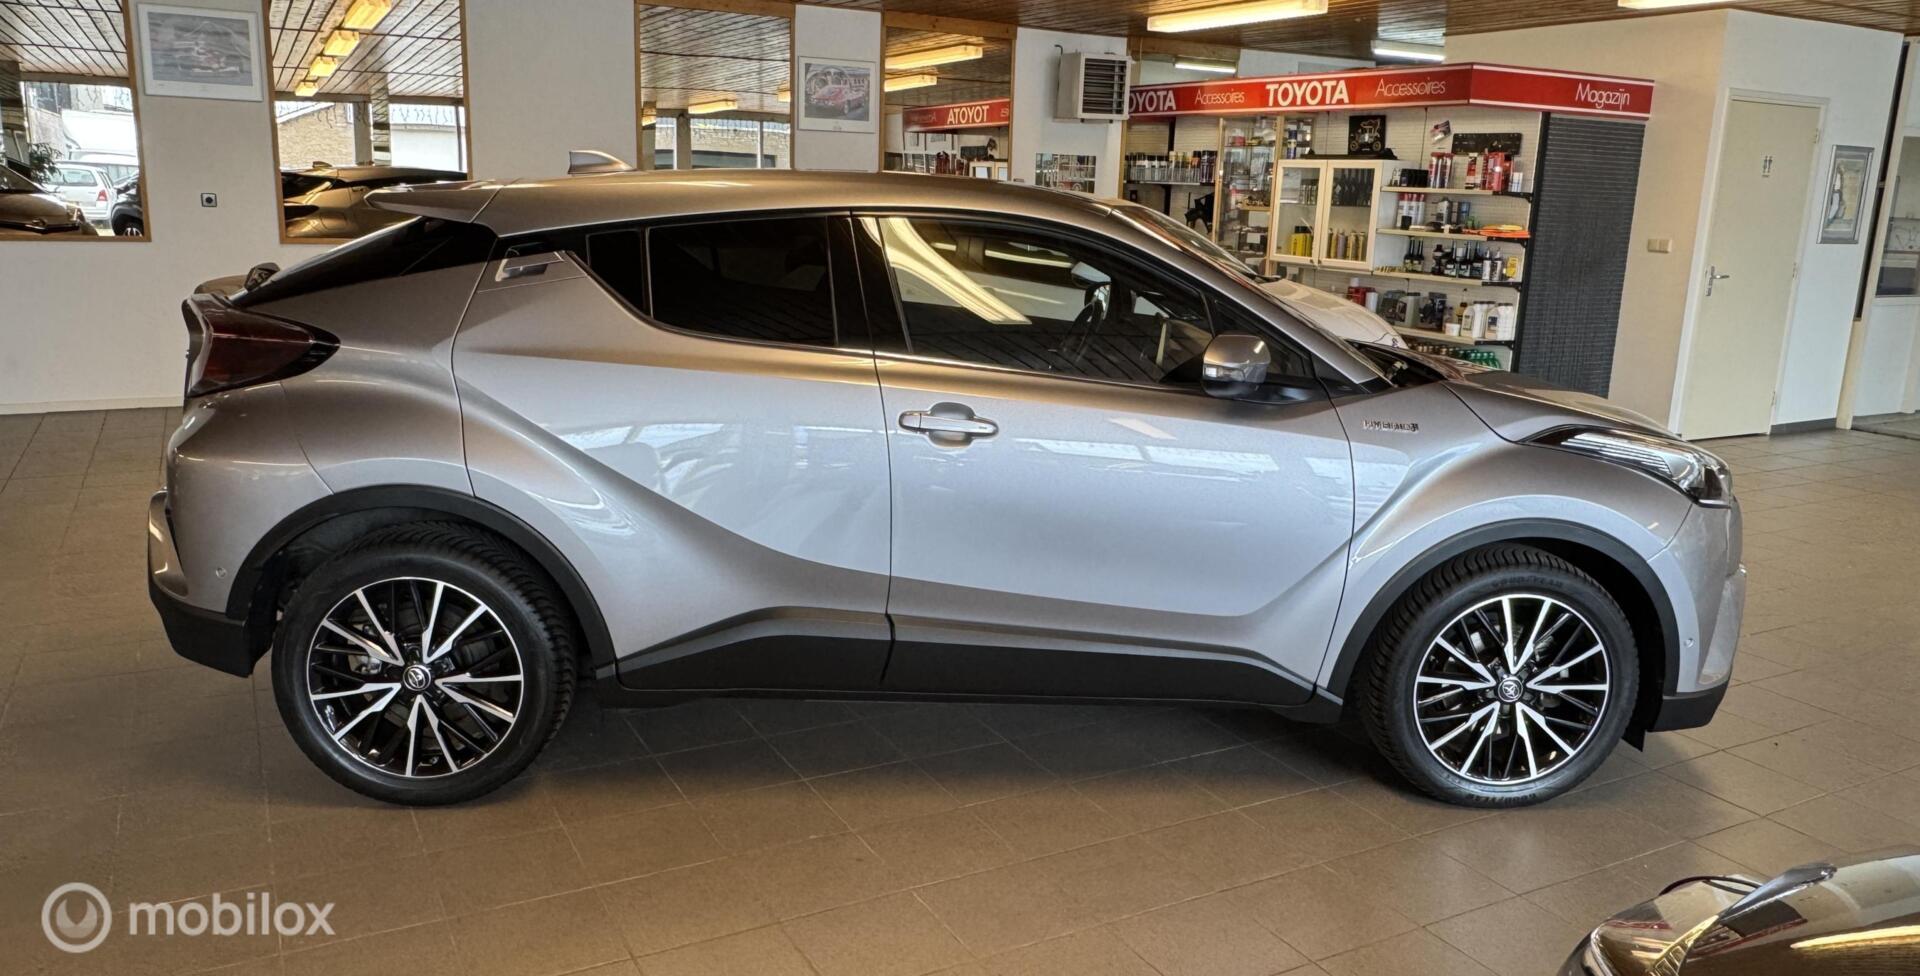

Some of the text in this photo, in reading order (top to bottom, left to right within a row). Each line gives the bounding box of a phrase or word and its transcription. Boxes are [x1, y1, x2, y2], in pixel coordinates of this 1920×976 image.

[1130, 76, 1446, 113] OYOTA Accessoires TOYOTA Accessoires
[1574, 81, 1631, 111] Magazijn
